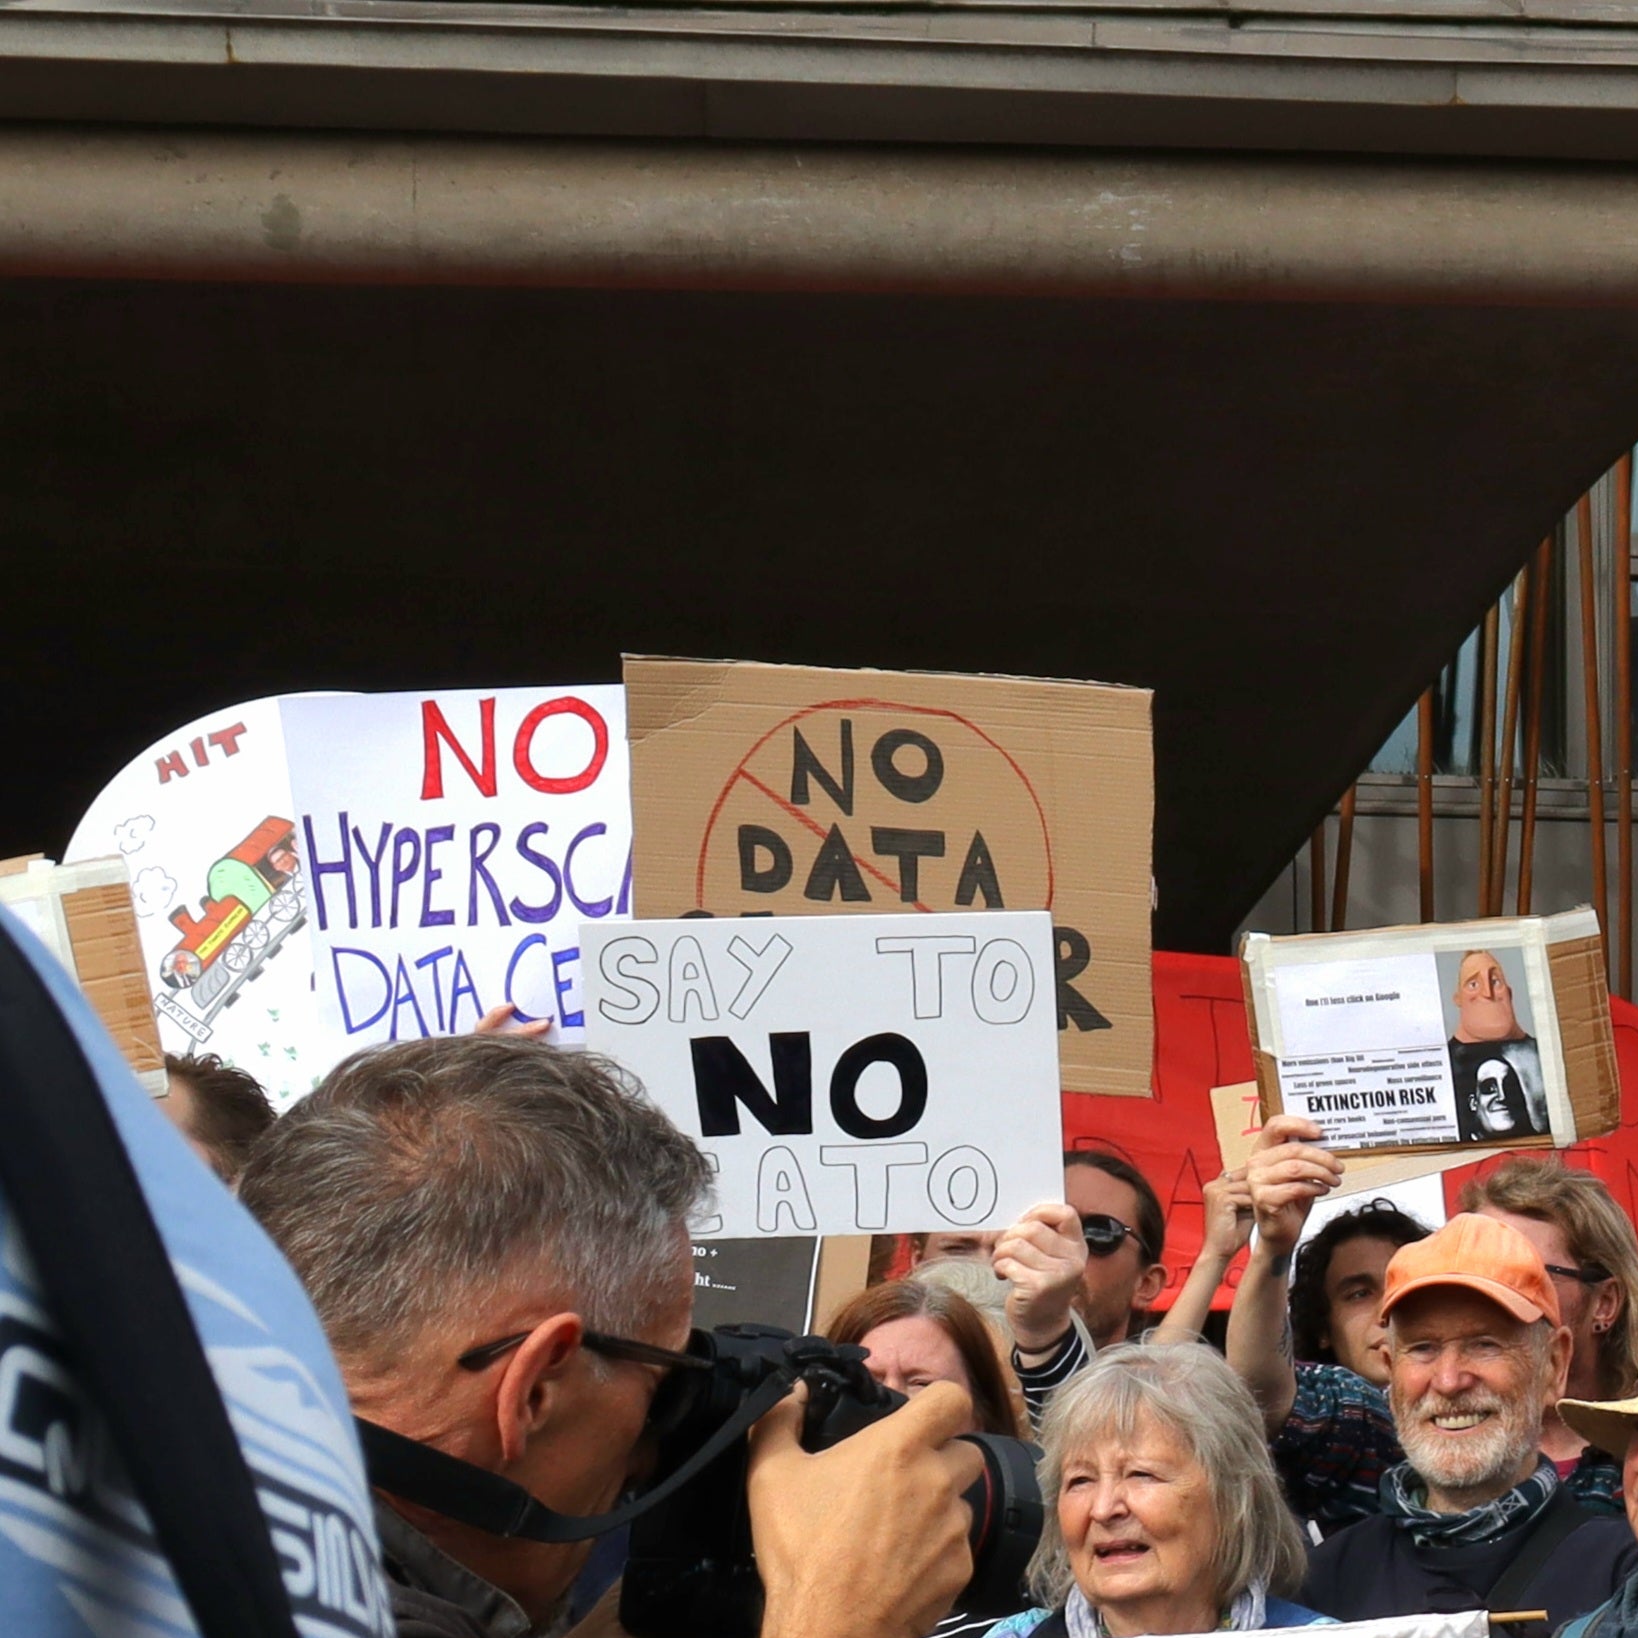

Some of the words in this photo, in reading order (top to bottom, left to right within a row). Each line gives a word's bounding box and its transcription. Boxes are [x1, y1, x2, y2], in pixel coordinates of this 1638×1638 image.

[154, 721, 247, 785] HIT
[420, 696, 609, 800] NO
[790, 719, 944, 816] NO
[303, 811, 632, 931] HYPERSC
[737, 821, 1005, 909] DATA
[160, 998, 206, 1036] NATURE
[331, 945, 484, 1041] DATA
[599, 933, 793, 1025] SAY
[876, 936, 1036, 1025] TO
[690, 1031, 928, 1139] NO
[1307, 1091, 1397, 1113] EXTINCTION
[1400, 1086, 1437, 1106] RISK
